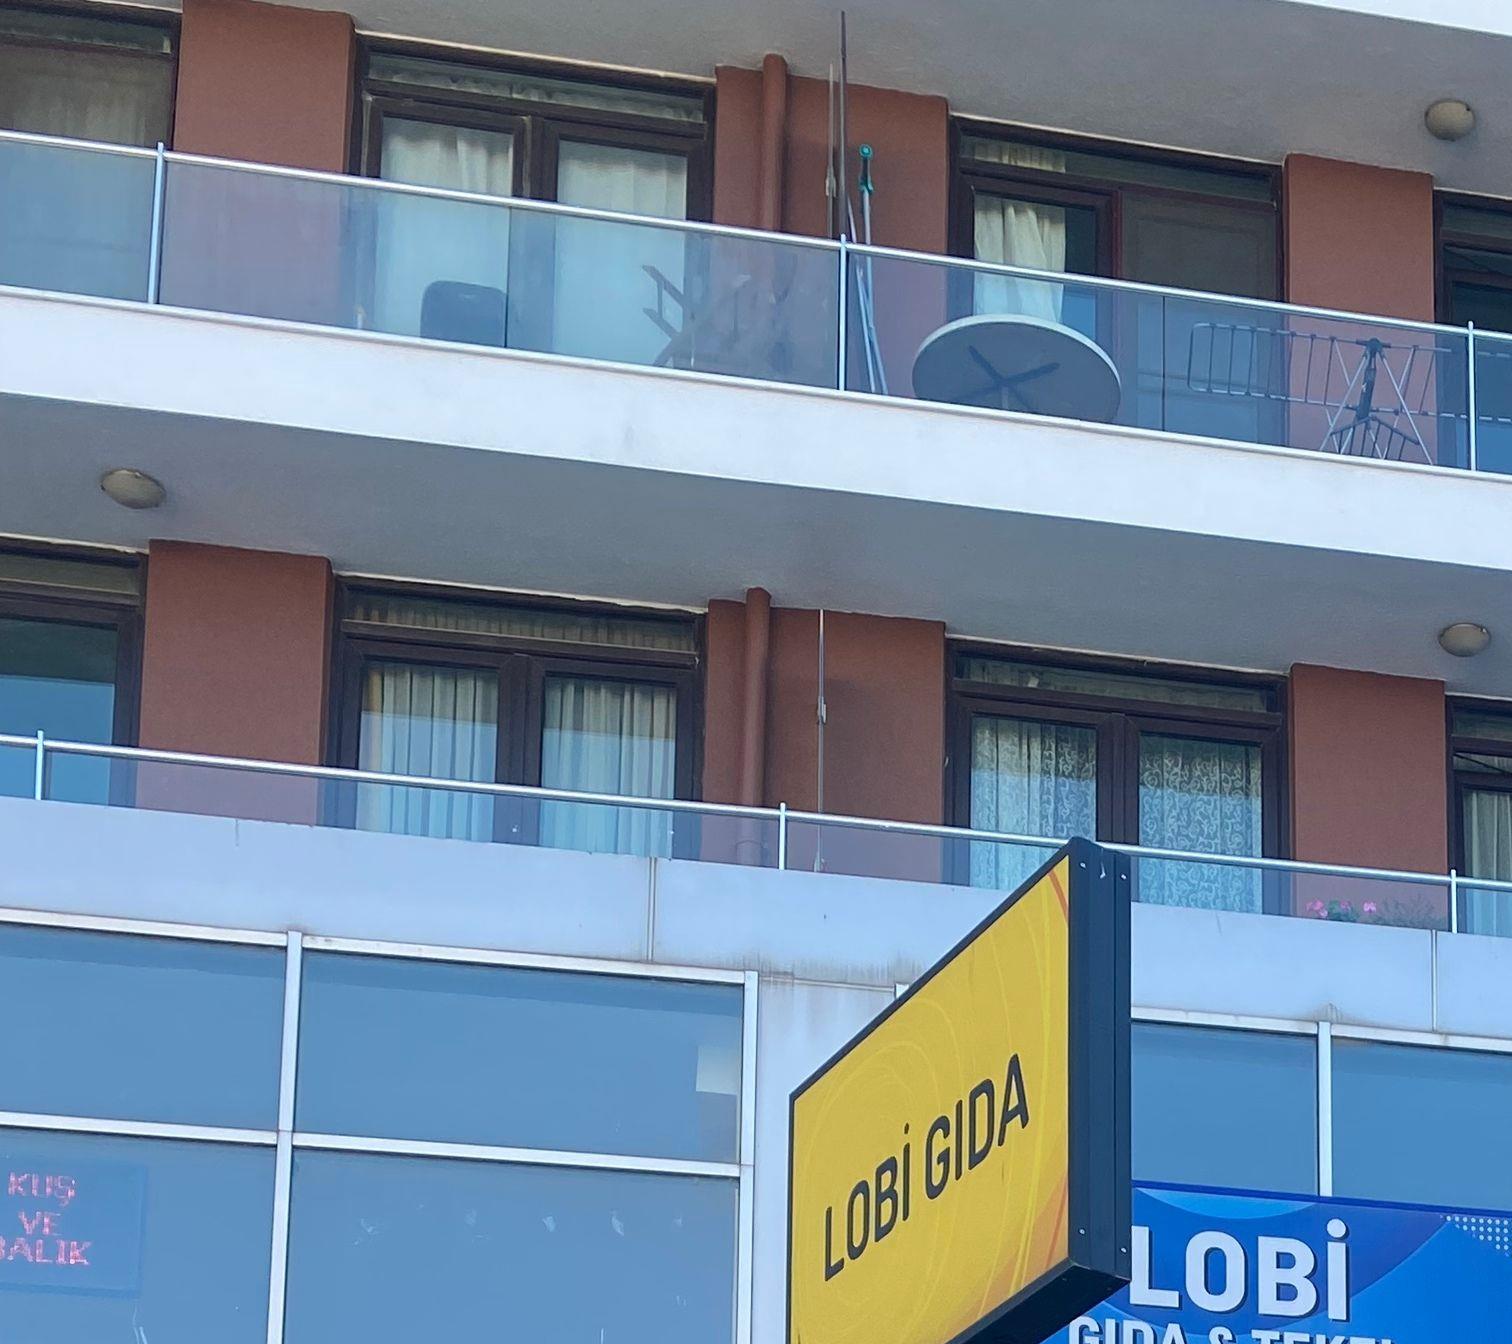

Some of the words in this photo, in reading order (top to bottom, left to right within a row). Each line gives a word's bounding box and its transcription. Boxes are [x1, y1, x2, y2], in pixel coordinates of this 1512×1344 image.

[925, 1053, 1030, 1200] GIDA
[8, 1171, 76, 1207] KUŞ
[18, 1211, 62, 1236] VE
